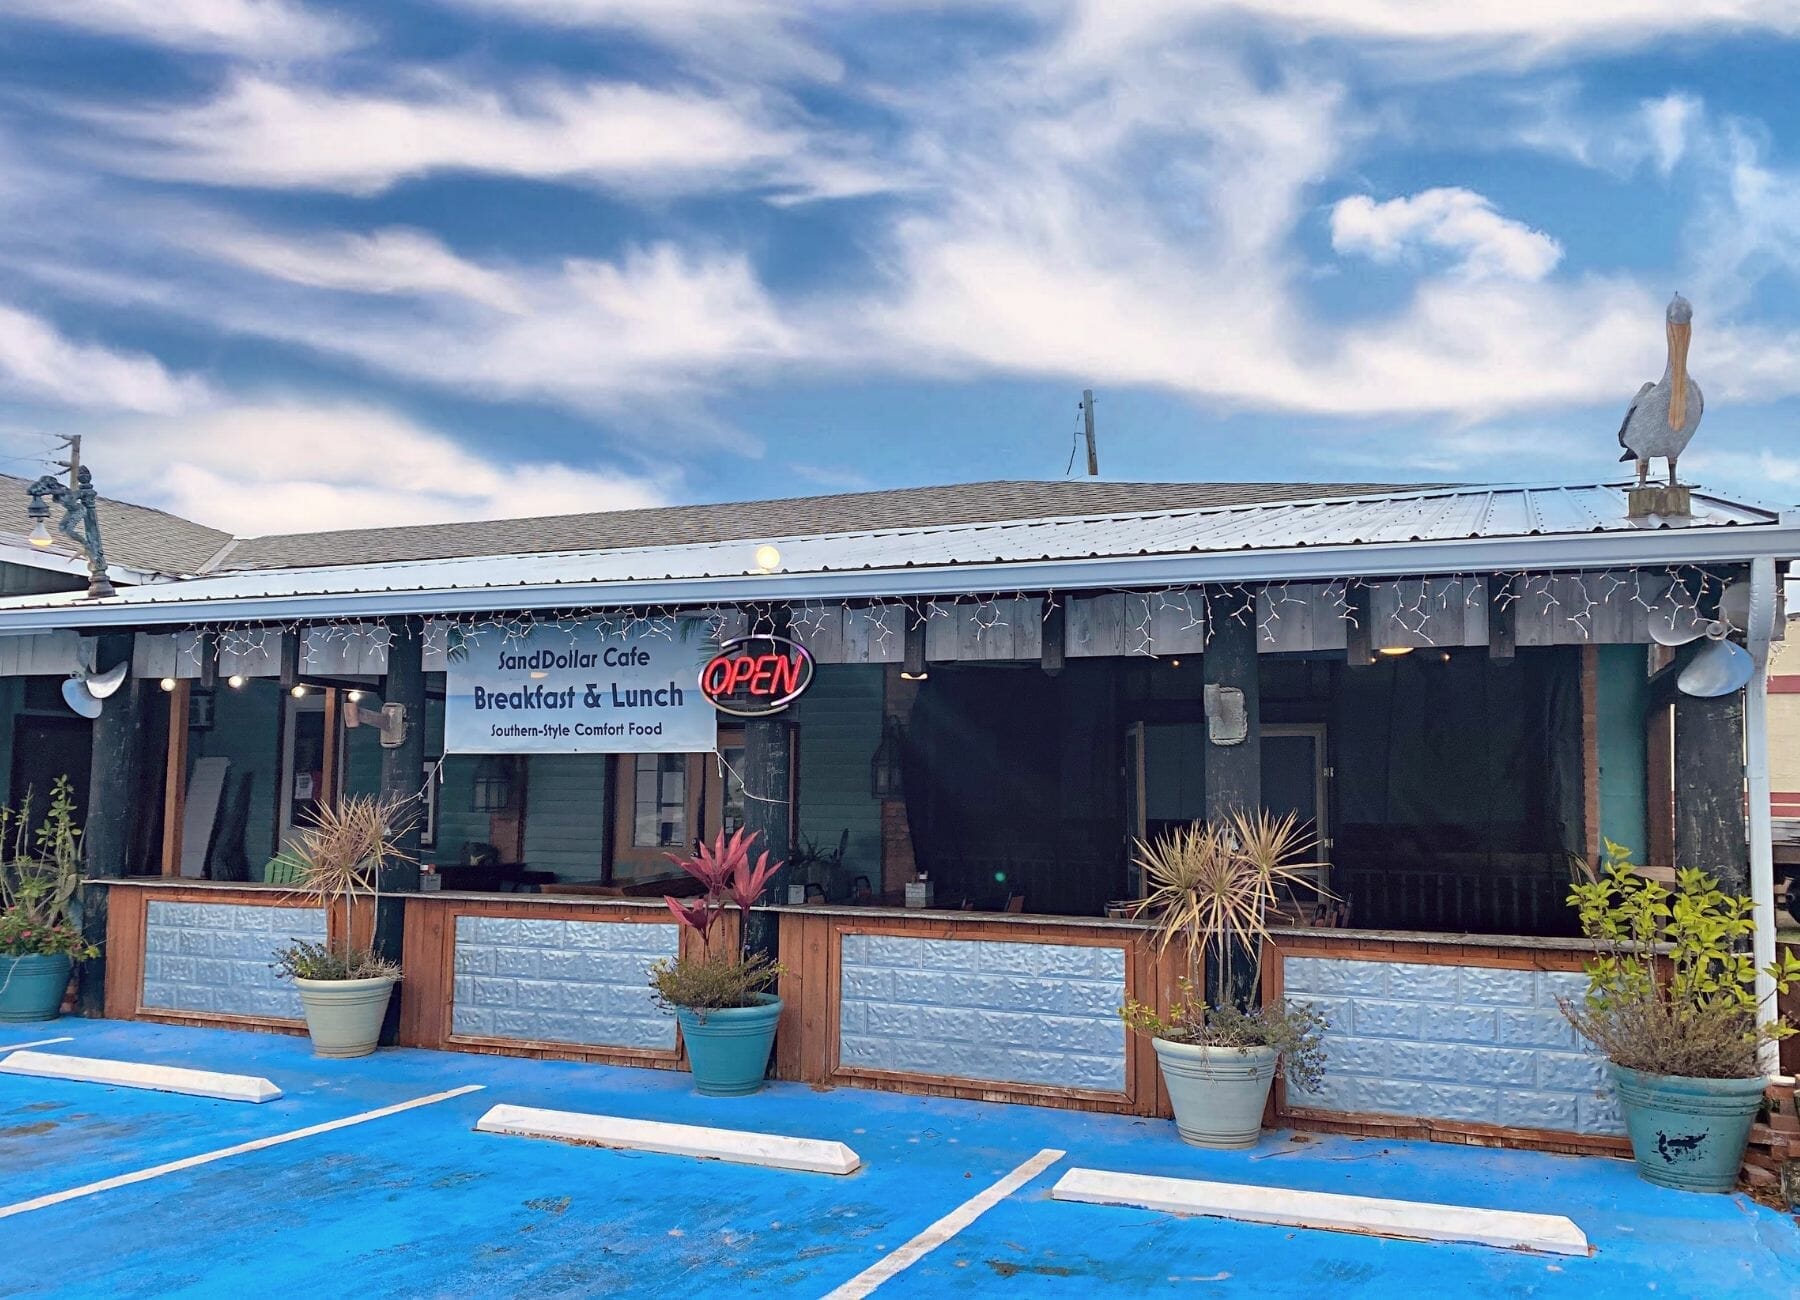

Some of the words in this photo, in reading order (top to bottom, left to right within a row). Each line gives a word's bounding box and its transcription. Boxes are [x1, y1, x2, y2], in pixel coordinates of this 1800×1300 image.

[603, 646, 650, 667] Cafe
[702, 654, 803, 696] OPEN
[474, 684, 575, 711] Breakfast
[583, 683, 602, 708] &
[612, 682, 684, 708] Lunch
[491, 724, 571, 739] Southern-Style
[574, 723, 625, 737] Comfort
[629, 722, 663, 736] Food
